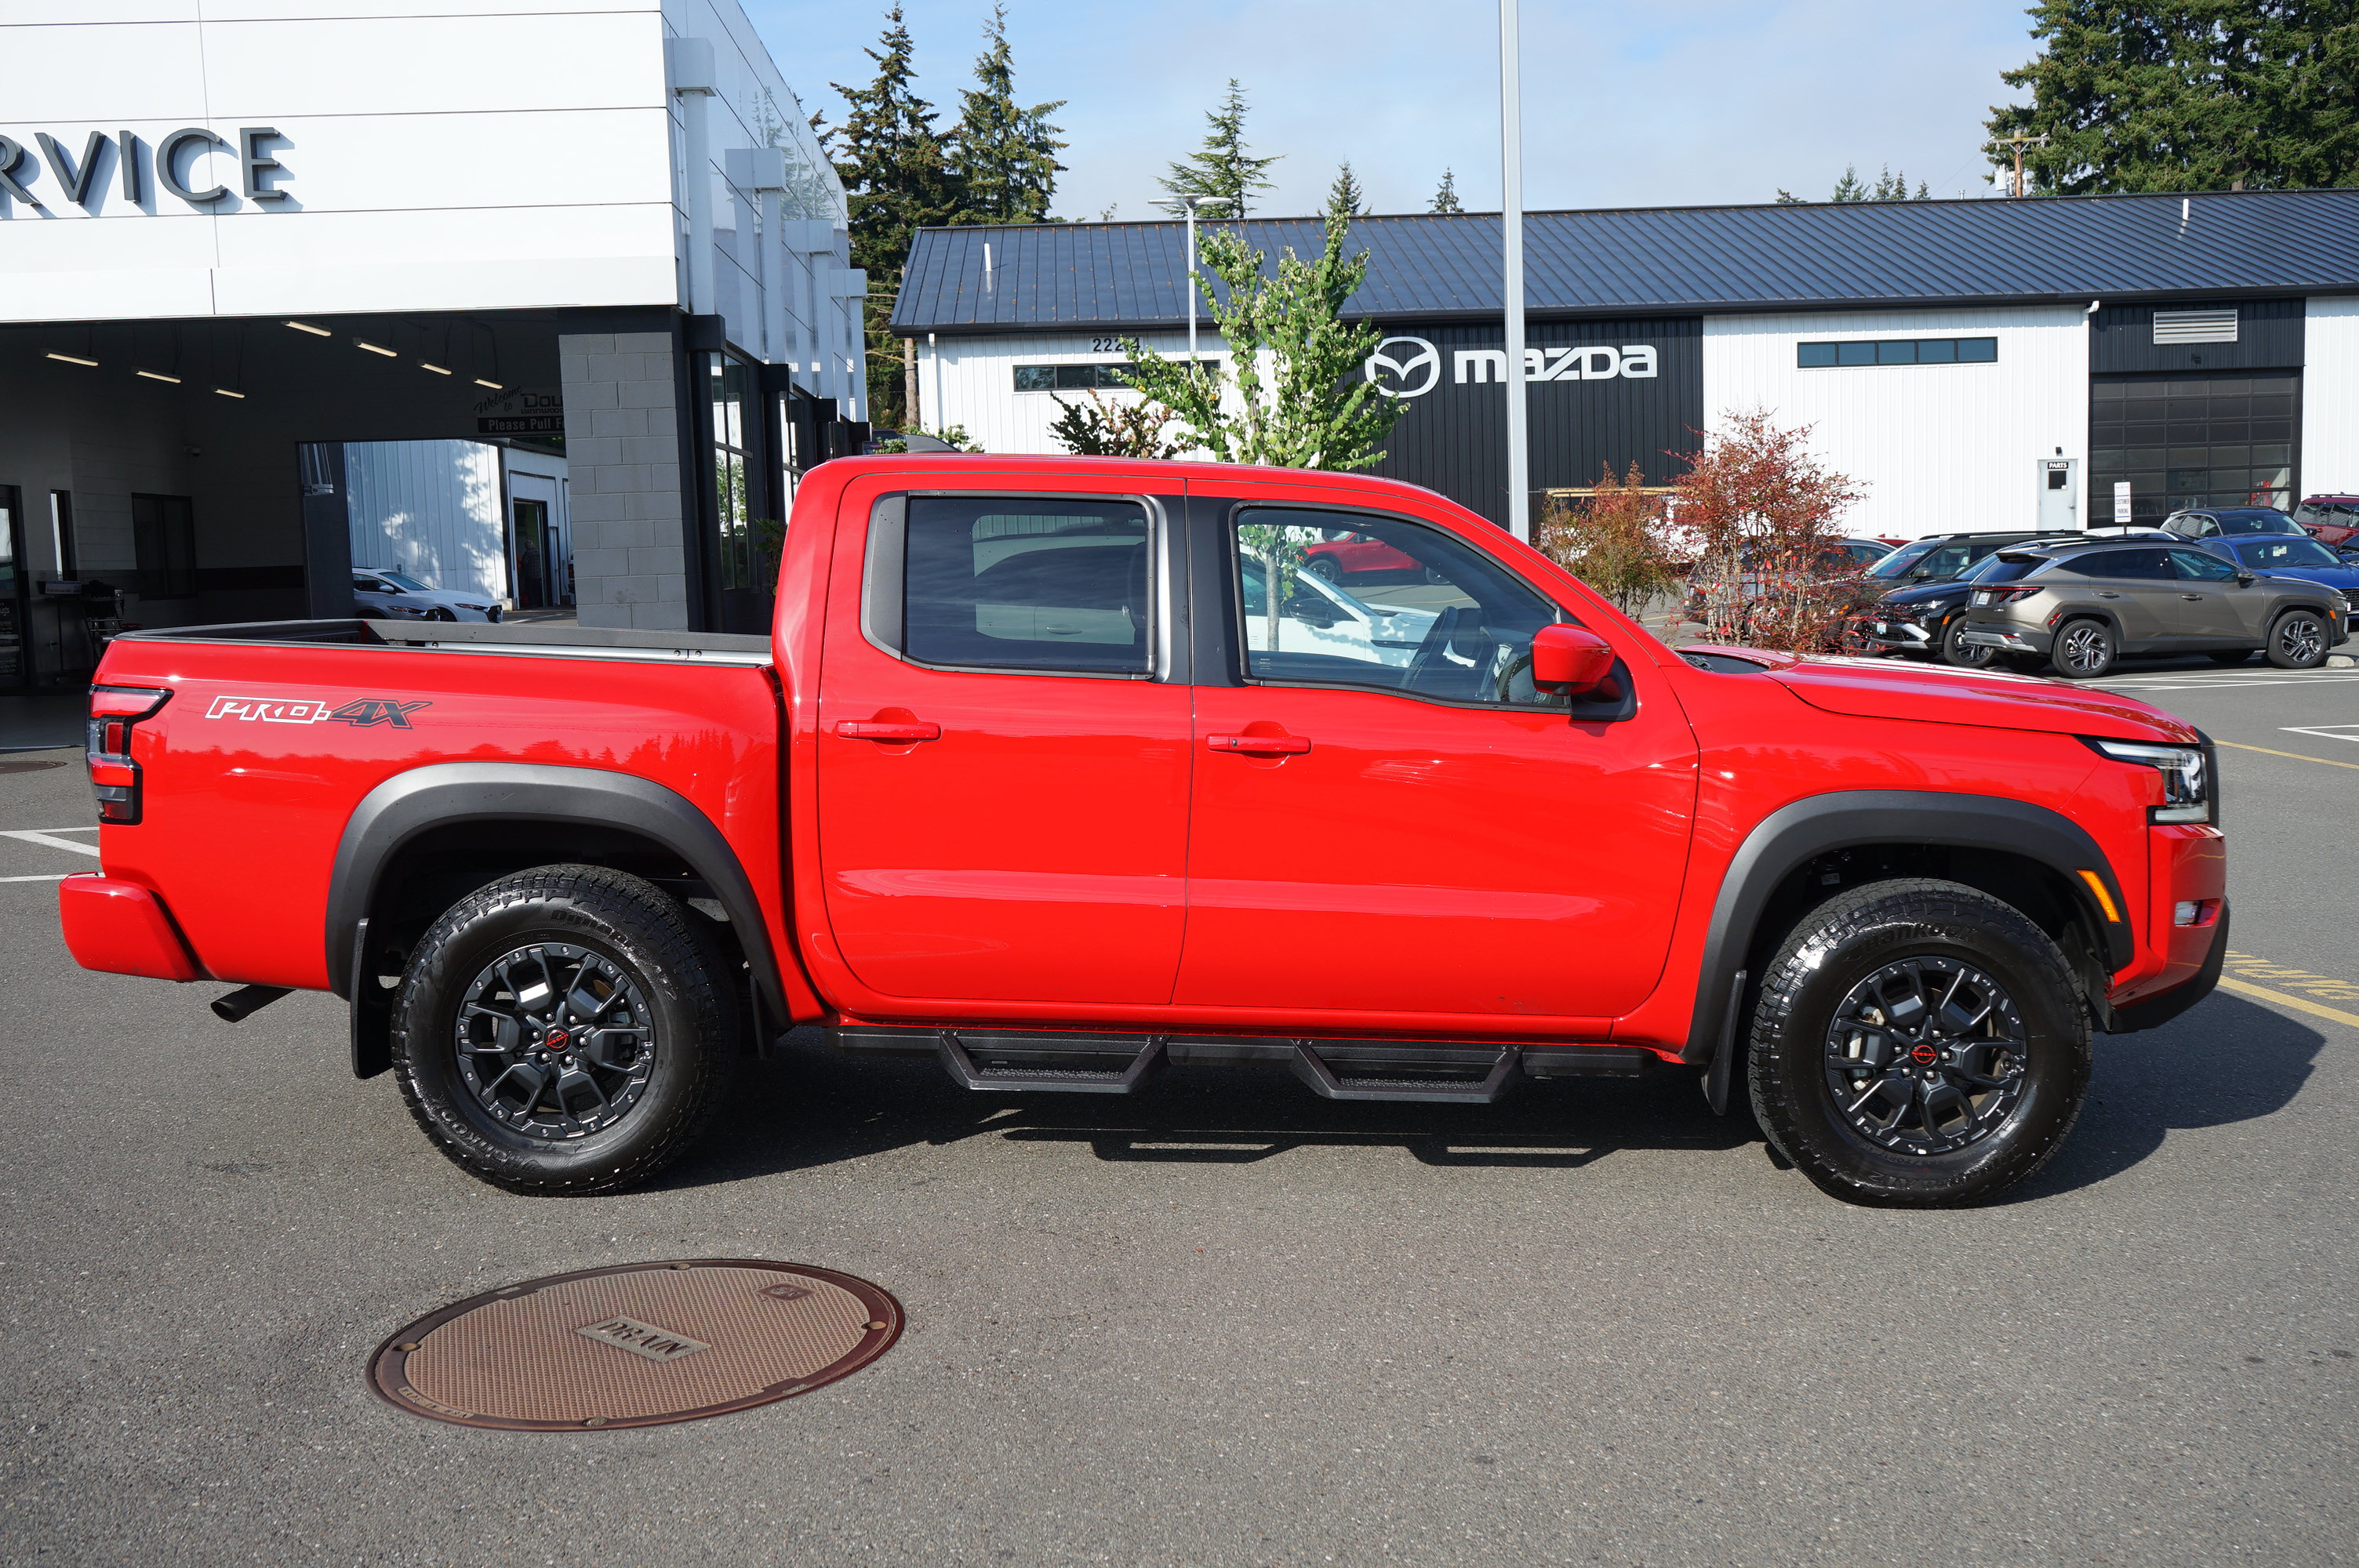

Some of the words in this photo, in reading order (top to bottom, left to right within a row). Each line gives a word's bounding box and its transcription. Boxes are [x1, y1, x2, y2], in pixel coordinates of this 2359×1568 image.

[473, 385, 523, 414] Welcome
[503, 401, 514, 413] to
[489, 419, 525, 431] Please
[530, 417, 551, 430] Pull
[596, 1321, 690, 1356] DRAIN
